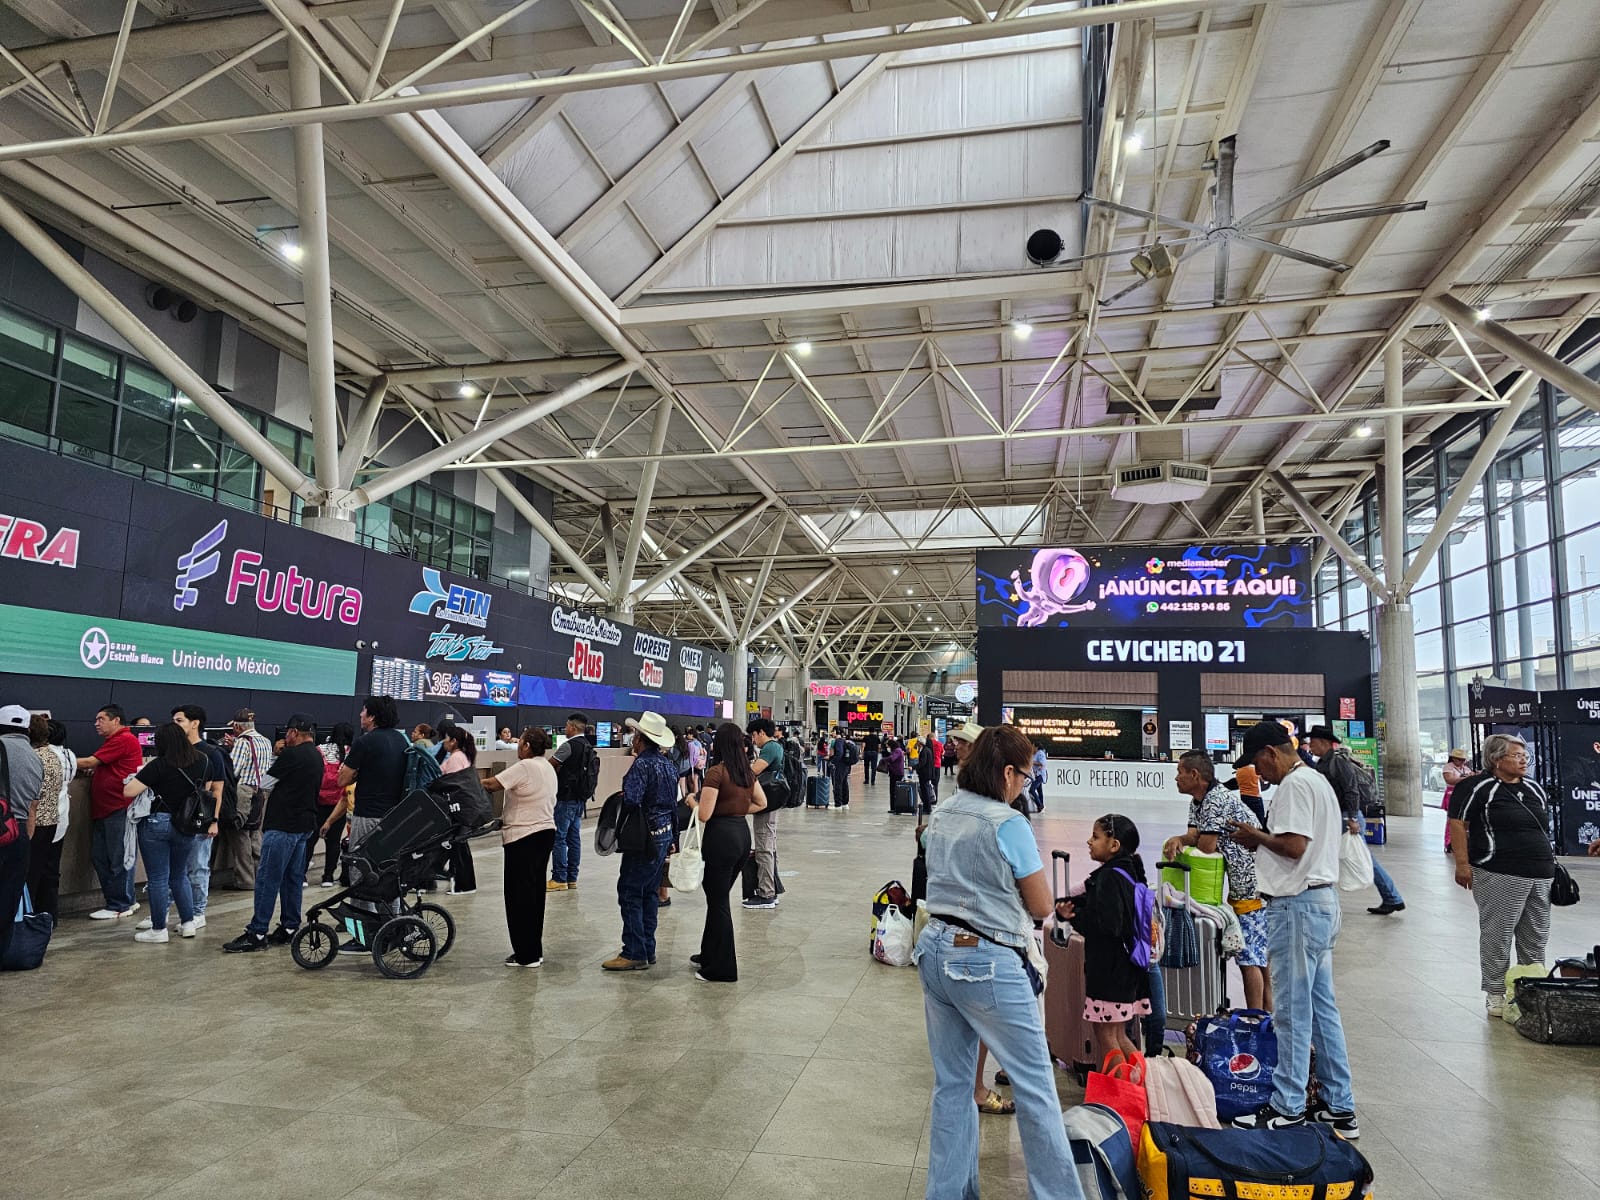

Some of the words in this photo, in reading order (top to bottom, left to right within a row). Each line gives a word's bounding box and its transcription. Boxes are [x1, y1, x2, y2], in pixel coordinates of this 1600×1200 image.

[226, 549, 363, 625] Futura
[1099, 576, 1228, 599] ¡ANÚNCIATE
[1232, 575, 1296, 596] AQUÍ!
[446, 584, 492, 619] ETN
[1160, 603, 1181, 611] 442
[1181, 603, 1200, 611] 158
[1201, 603, 1215, 611] 94
[109, 651, 139, 663] Estrella
[110, 642, 136, 652] GRUPO
[634, 632, 671, 662] NORESTE
[1087, 640, 1214, 662] CEVICHERO
[1217, 640, 1245, 663] 21
[172, 649, 232, 671] Uniendo
[236, 656, 281, 676] México
[573, 638, 604, 682] Plus
[643, 660, 664, 688] Plus
[809, 681, 869, 699] Supervoy
[1576, 698, 1600, 710] ÚNE
[1057, 769, 1081, 785] RICO
[1090, 769, 1129, 787] PEEERO
[1136, 771, 1165, 789] RICO!
[1571, 786, 1600, 800] ÚNE
[1230, 1082, 1258, 1093] pepsi
